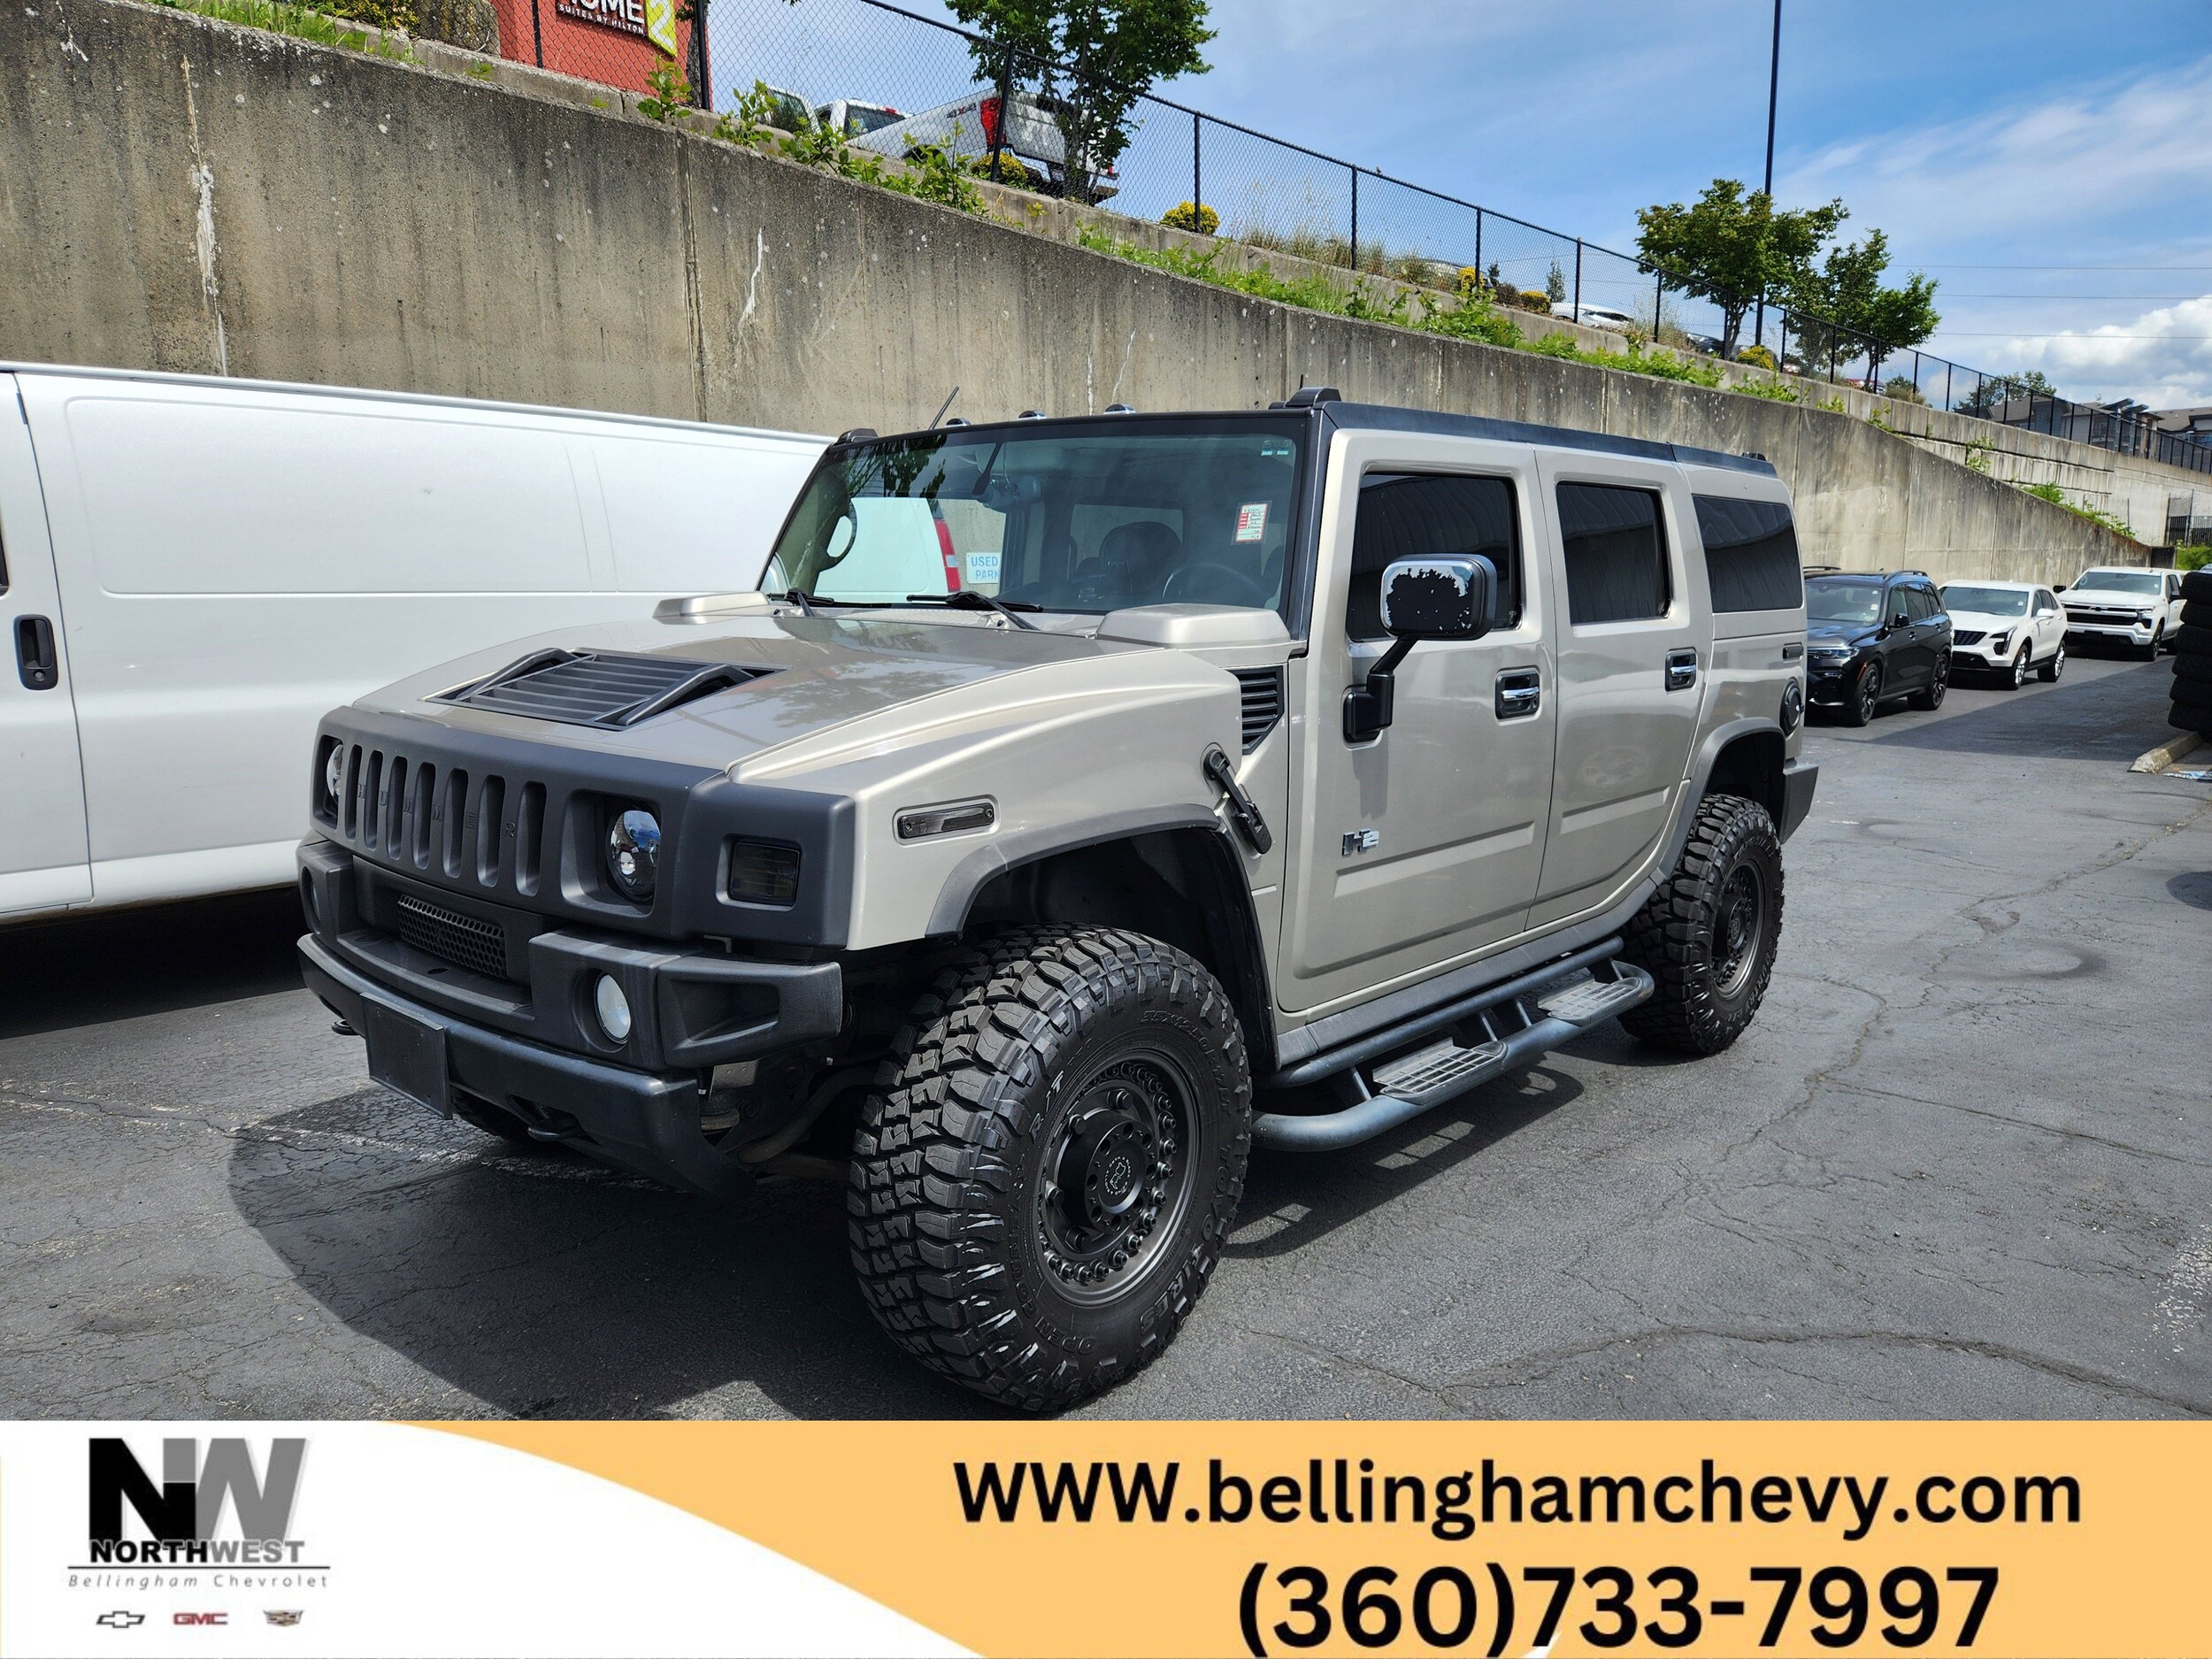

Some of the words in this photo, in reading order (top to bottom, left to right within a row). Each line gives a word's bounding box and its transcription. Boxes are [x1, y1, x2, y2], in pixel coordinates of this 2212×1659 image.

[559, 4, 594, 19] SUITES
[596, 15, 609, 24] BY
[611, 19, 645, 35] HILTON
[972, 557, 998, 567] USED
[1341, 827, 1380, 857] H2
[1034, 1316, 1097, 1356] OPEN
